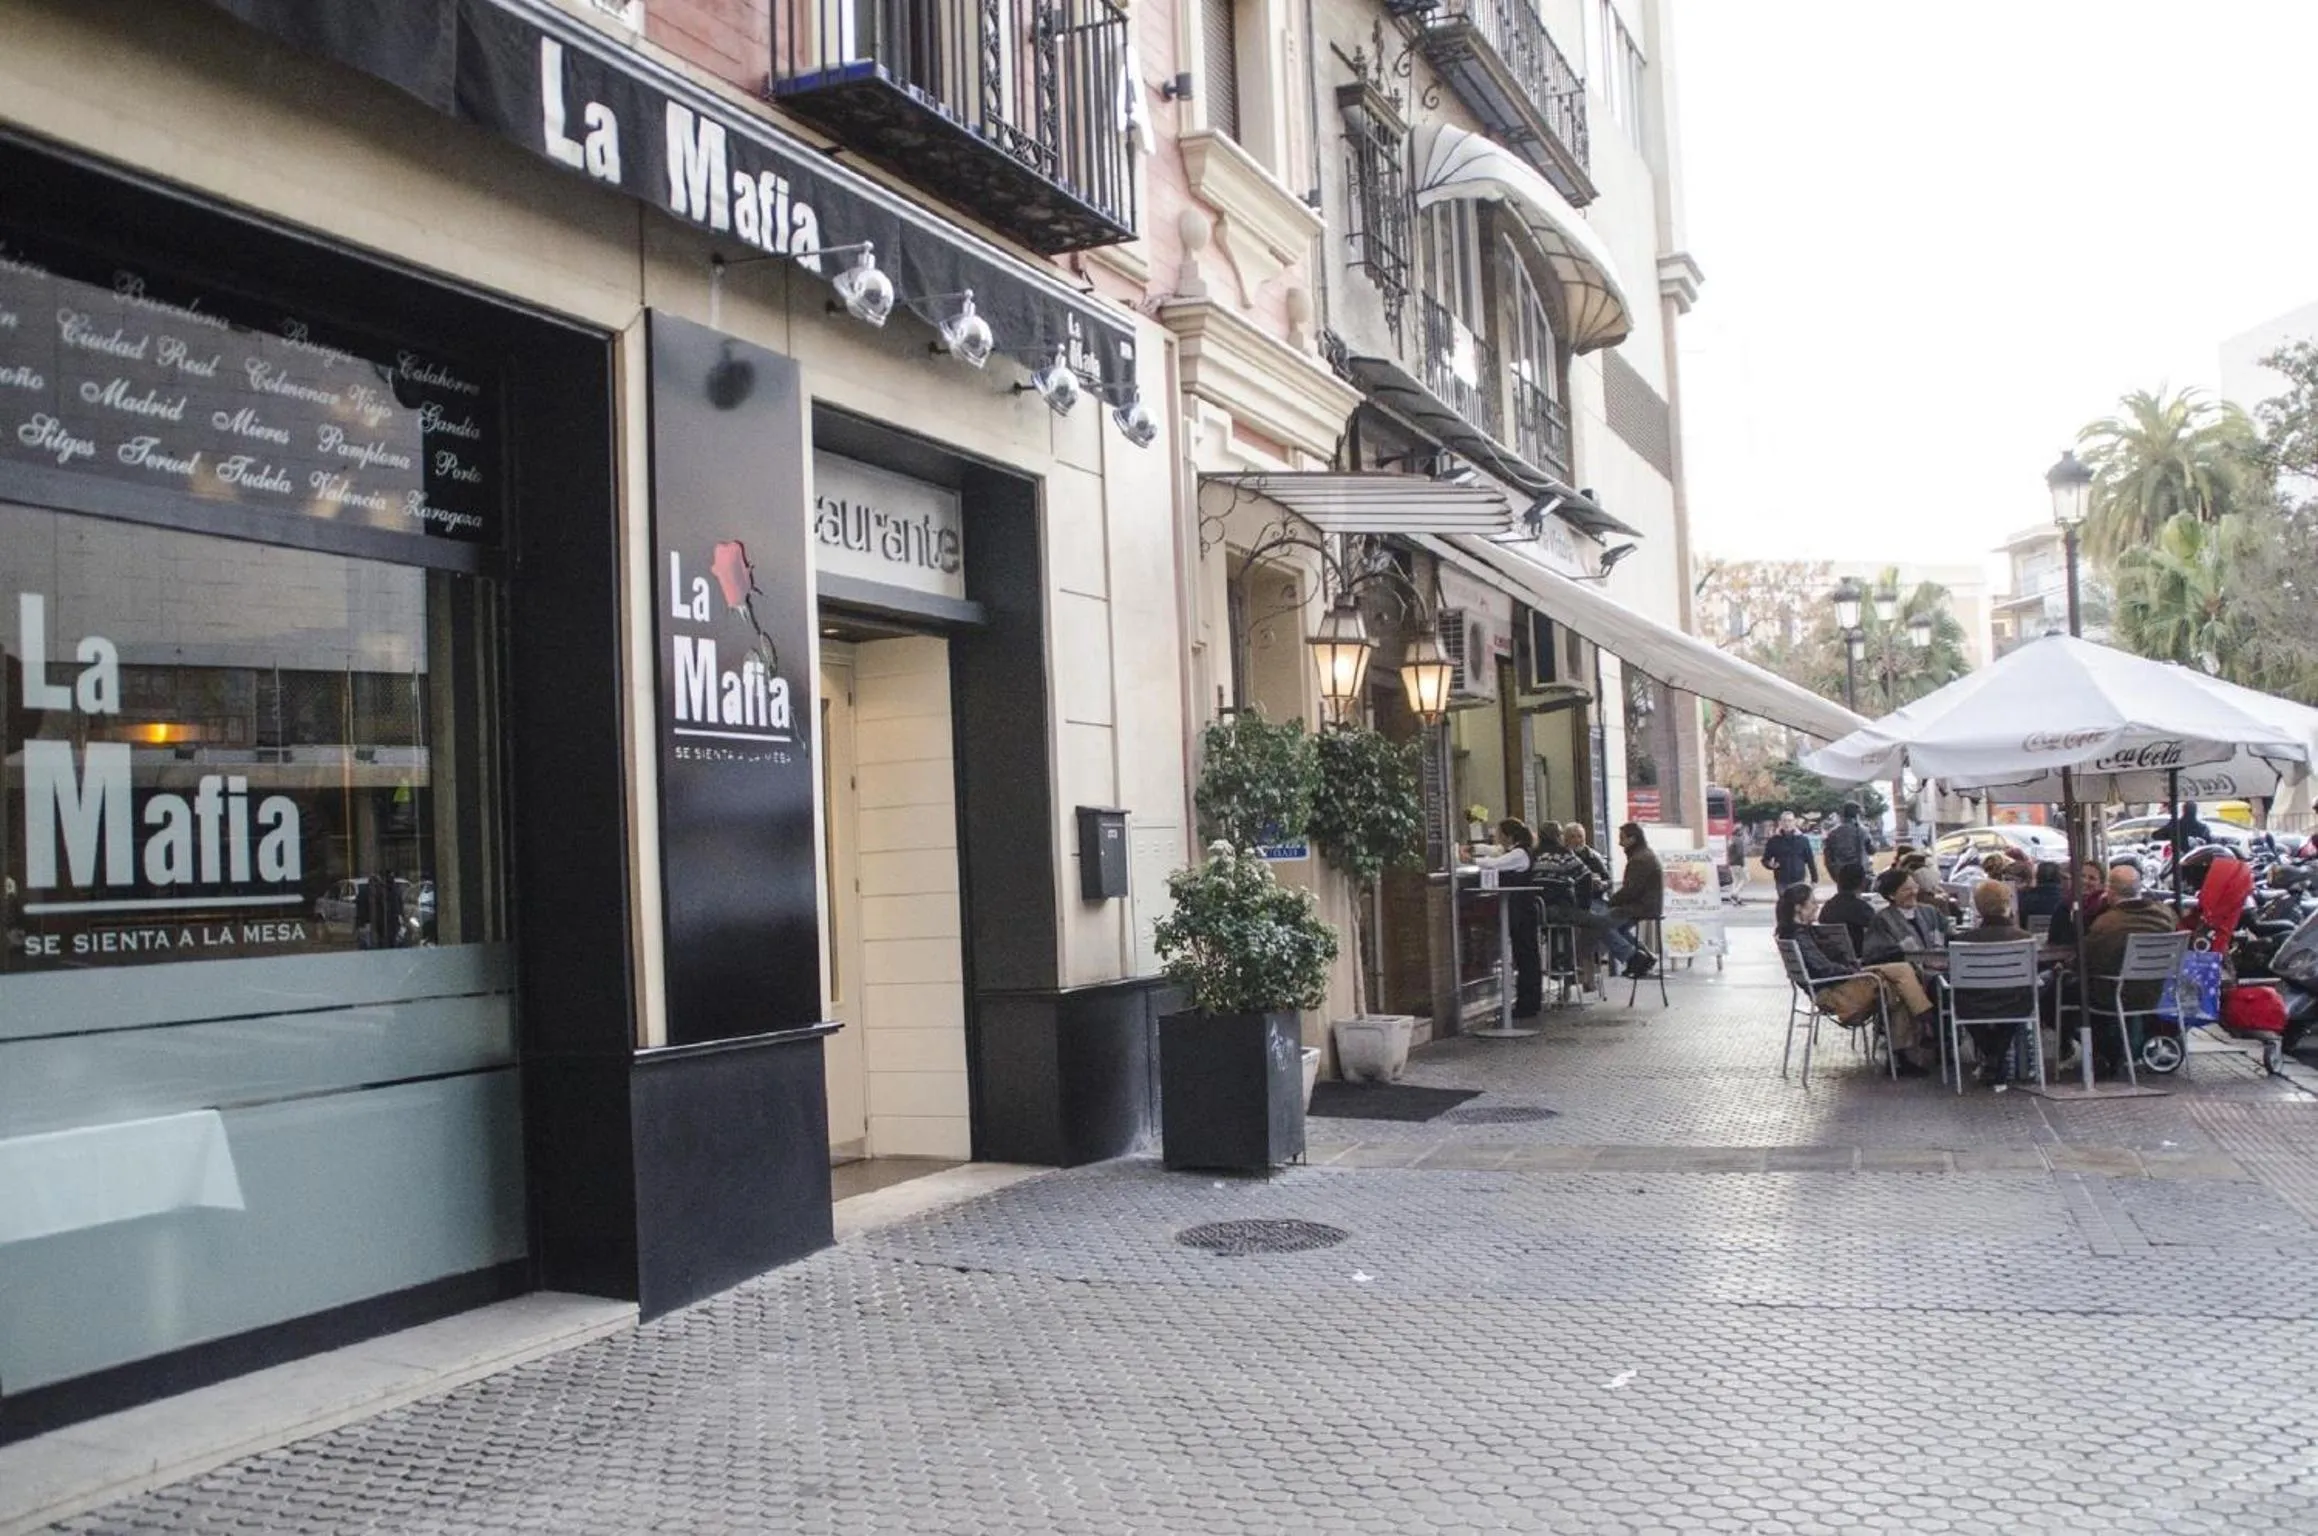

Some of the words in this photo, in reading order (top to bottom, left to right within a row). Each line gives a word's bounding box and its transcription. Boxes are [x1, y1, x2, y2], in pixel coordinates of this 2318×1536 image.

[541, 36, 622, 184] La
[666, 100, 822, 272] Mafia
[56, 308, 149, 360] Ciudad
[156, 335, 221, 377] Real
[244, 357, 341, 405] Colmenar
[1067, 311, 1081, 339] La
[80, 378, 187, 422] Madrid
[212, 408, 290, 446] Mieres
[317, 422, 412, 471] Pamplona
[17, 412, 96, 464] Sitges
[117, 436, 202, 475] Teruel
[215, 455, 293, 495] Tudela
[309, 470, 387, 512] Valencia
[403, 488, 483, 532] Zaragoza
[670, 551, 710, 622] La
[20, 593, 119, 715] La
[673, 635, 790, 728] Mafia
[675, 746, 690, 759] SE
[23, 739, 301, 889] Mafia
[24, 934, 61, 957] SE
[74, 929, 170, 953] SIENTA
[178, 927, 195, 947] A
[203, 926, 235, 946] LA
[243, 922, 306, 943] MESA
